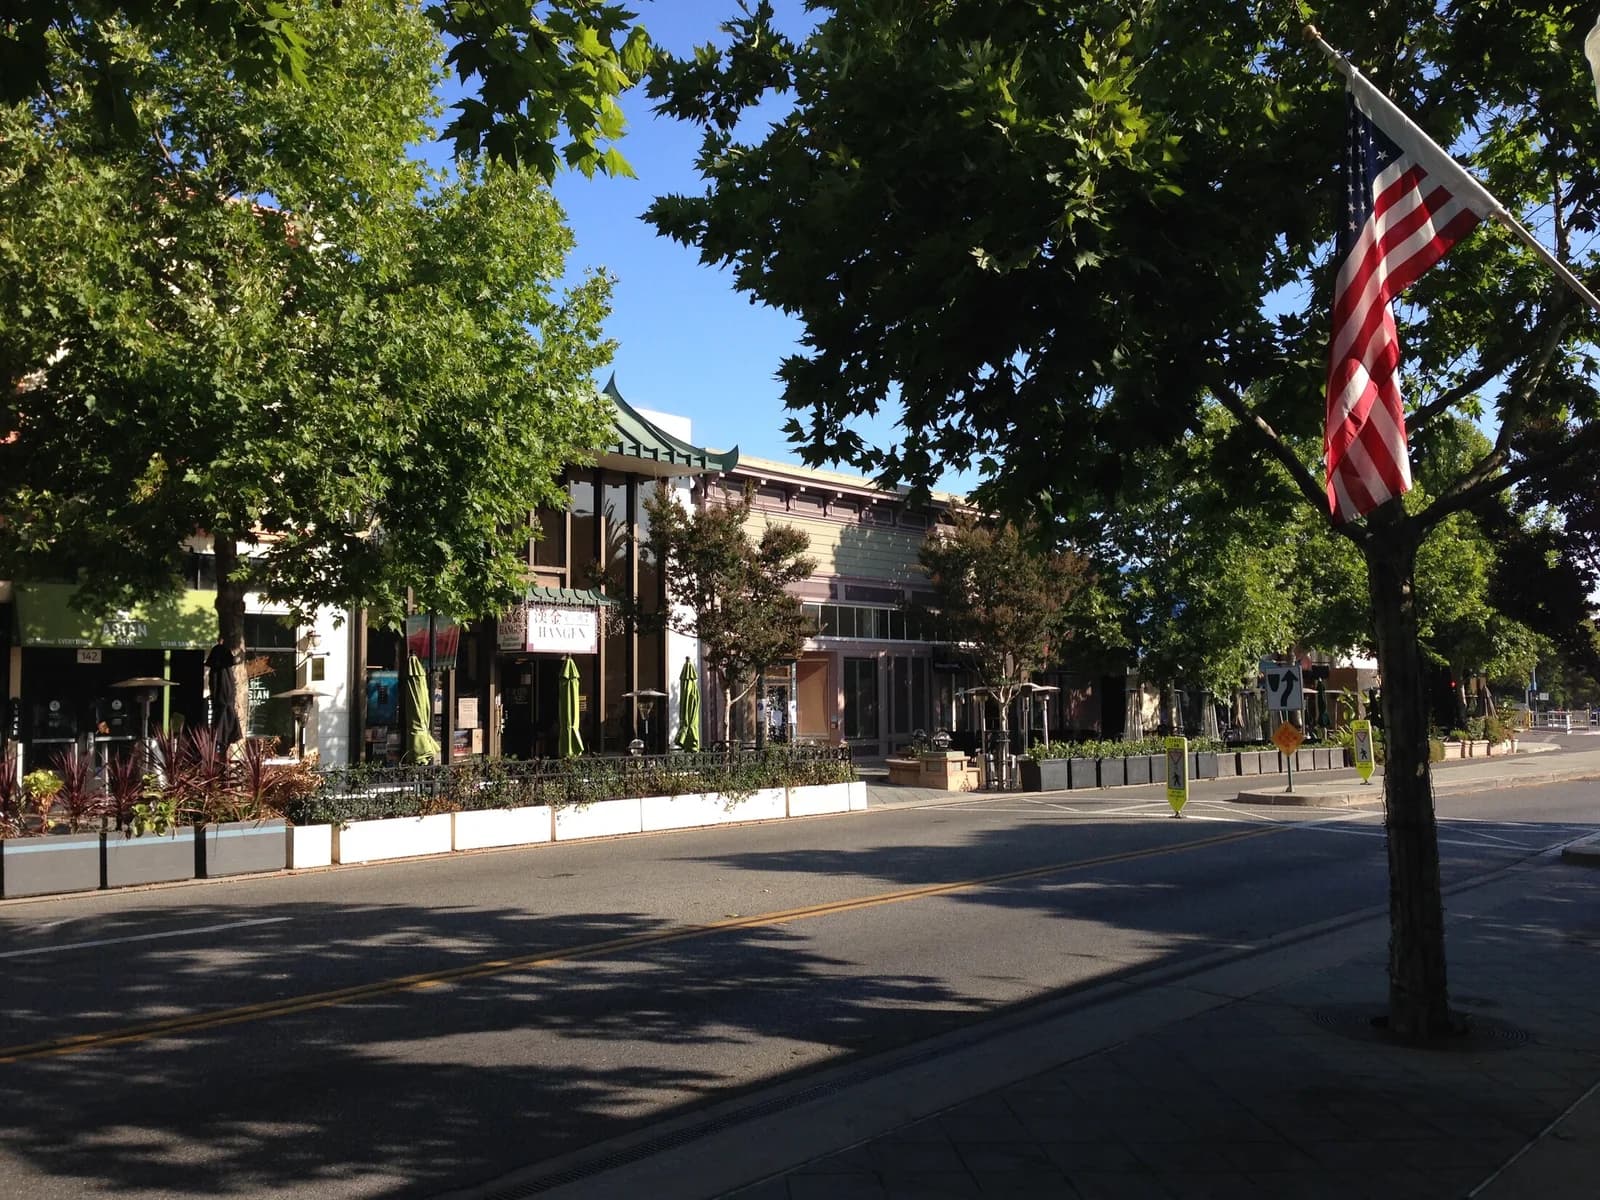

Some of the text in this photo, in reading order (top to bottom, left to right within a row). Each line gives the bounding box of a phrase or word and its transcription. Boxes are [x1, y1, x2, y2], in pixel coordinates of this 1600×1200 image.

[102, 622, 148, 638] ASIAN
[538, 625, 586, 639] HANGEN
[81, 651, 98, 661] 142
[247, 689, 270, 699] SIAN
